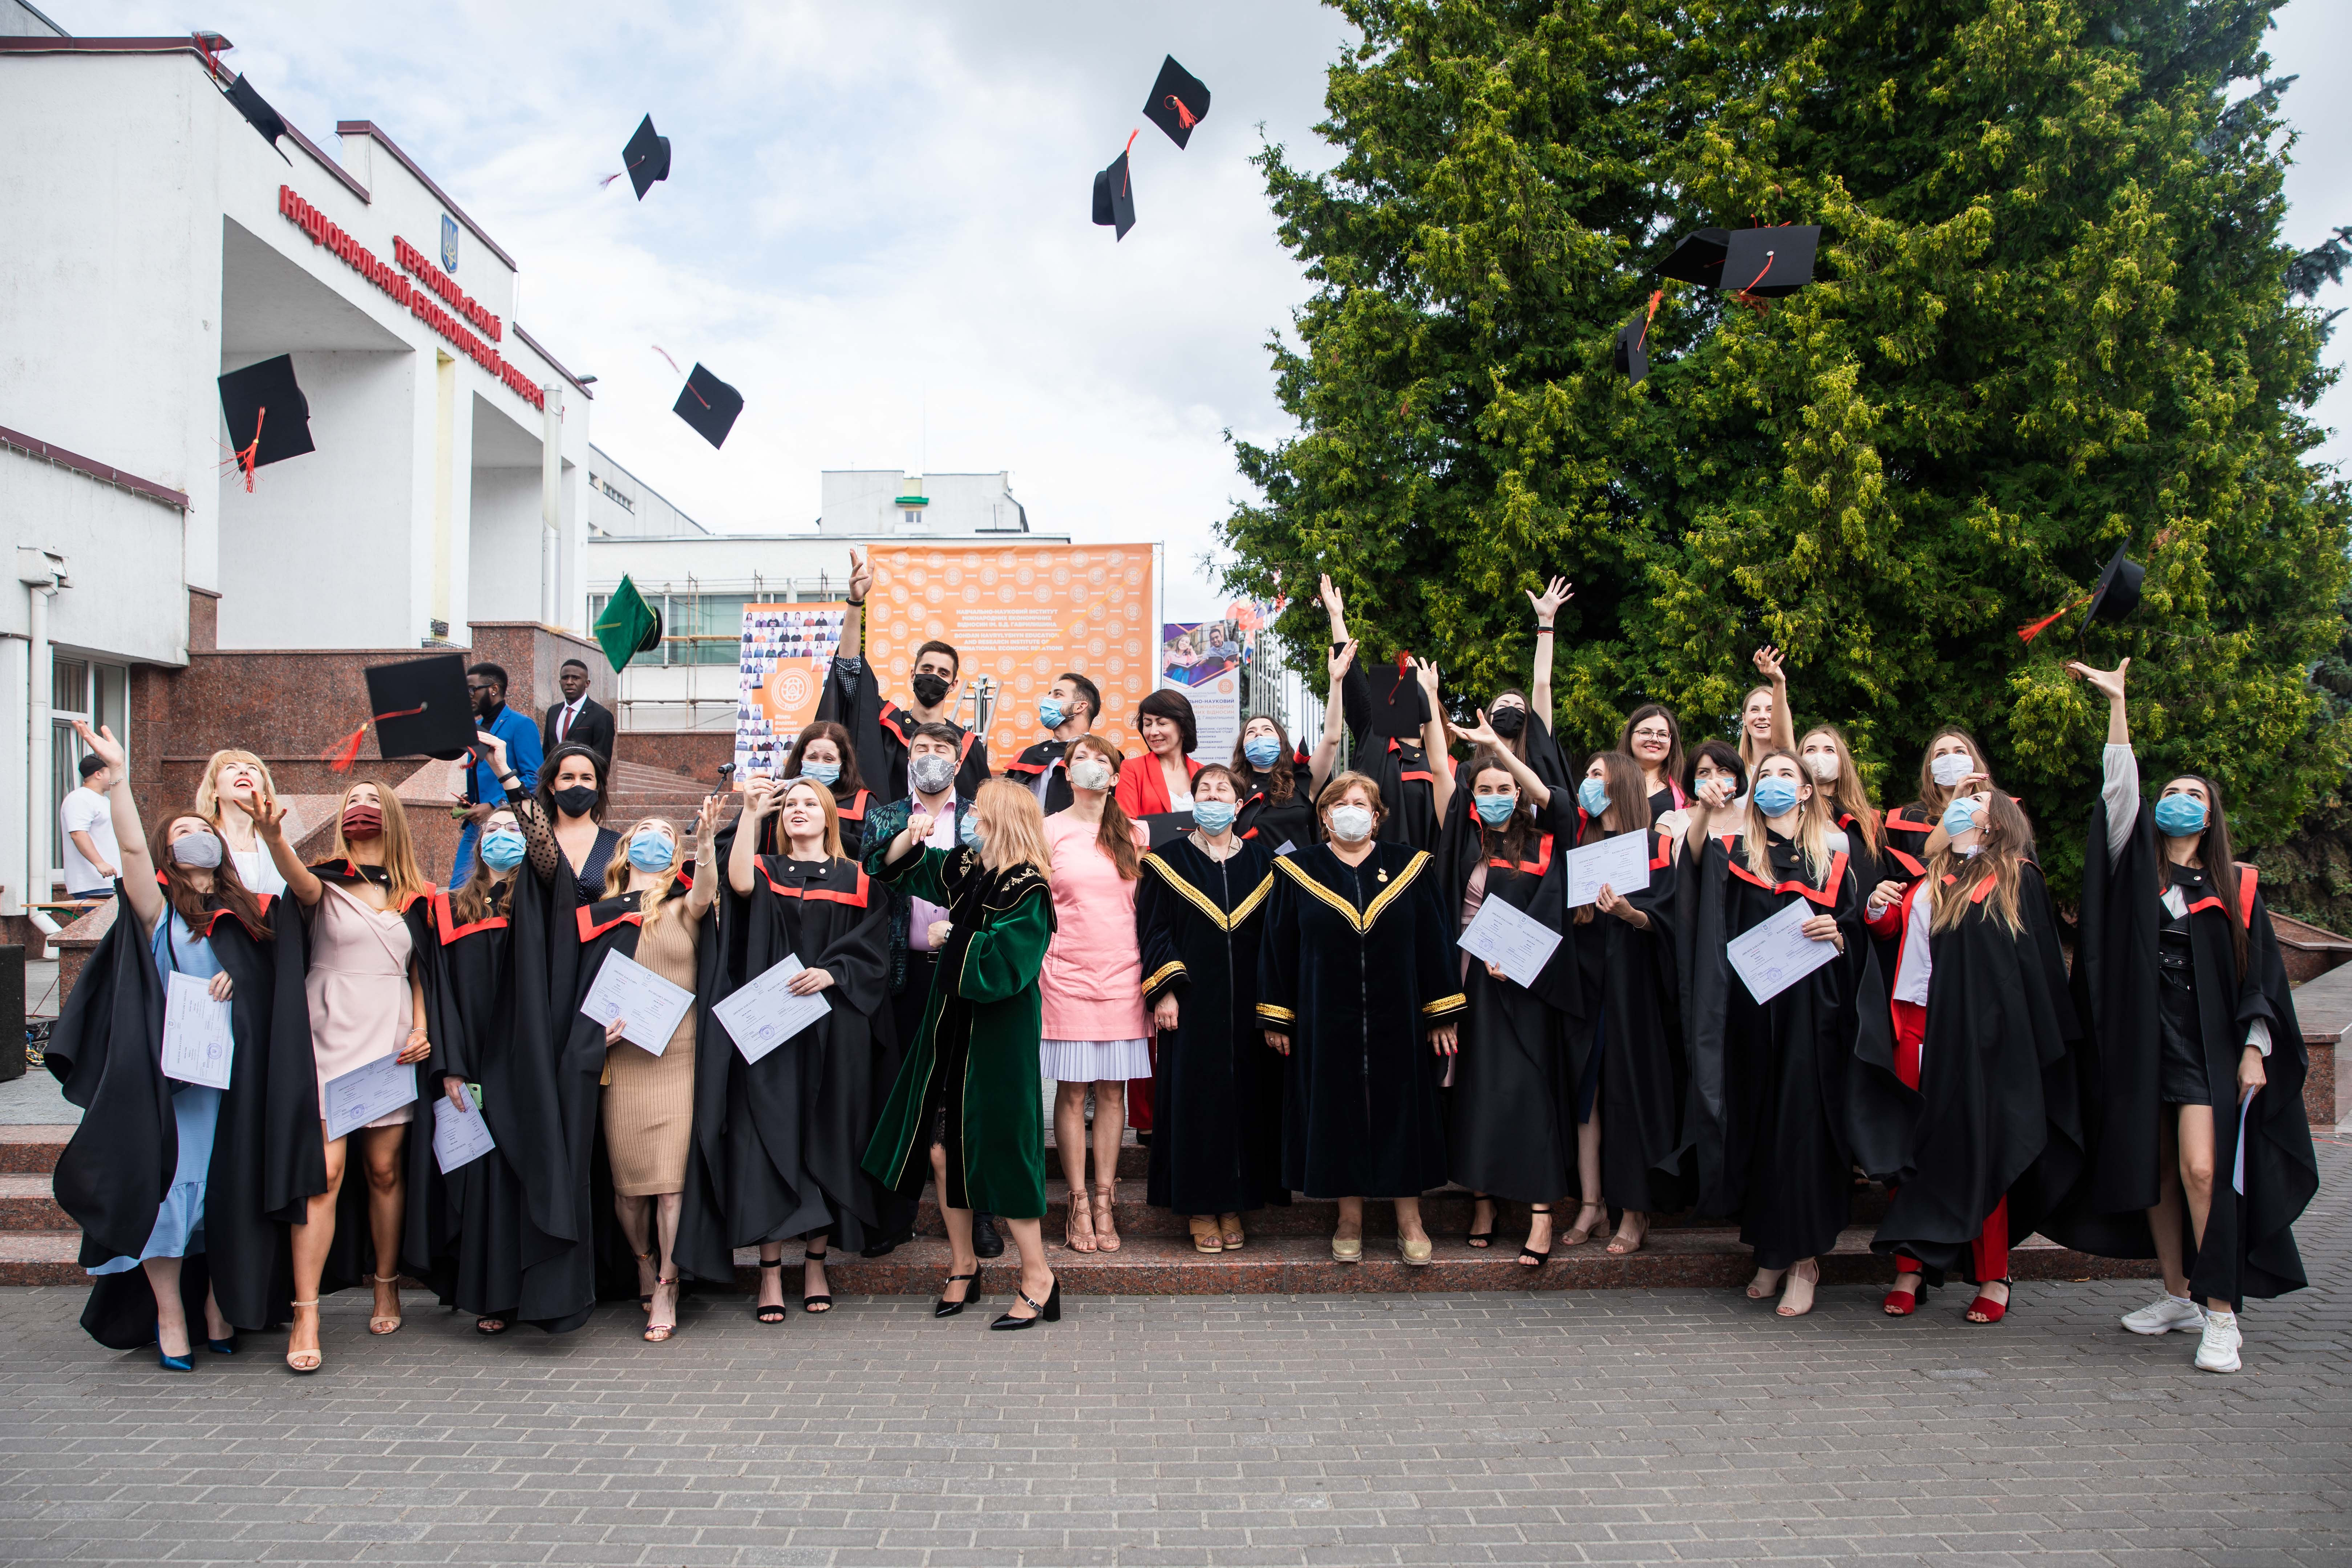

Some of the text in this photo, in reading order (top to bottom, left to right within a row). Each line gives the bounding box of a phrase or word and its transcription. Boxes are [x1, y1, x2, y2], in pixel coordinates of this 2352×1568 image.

[279, 185, 564, 424] НАЦІОНАЛЬНИЙ ЕКОНОМІЧНИЙ УНІВЕРС
[394, 236, 501, 342] ТЕРНОПІЛЬСЬКИЙ
